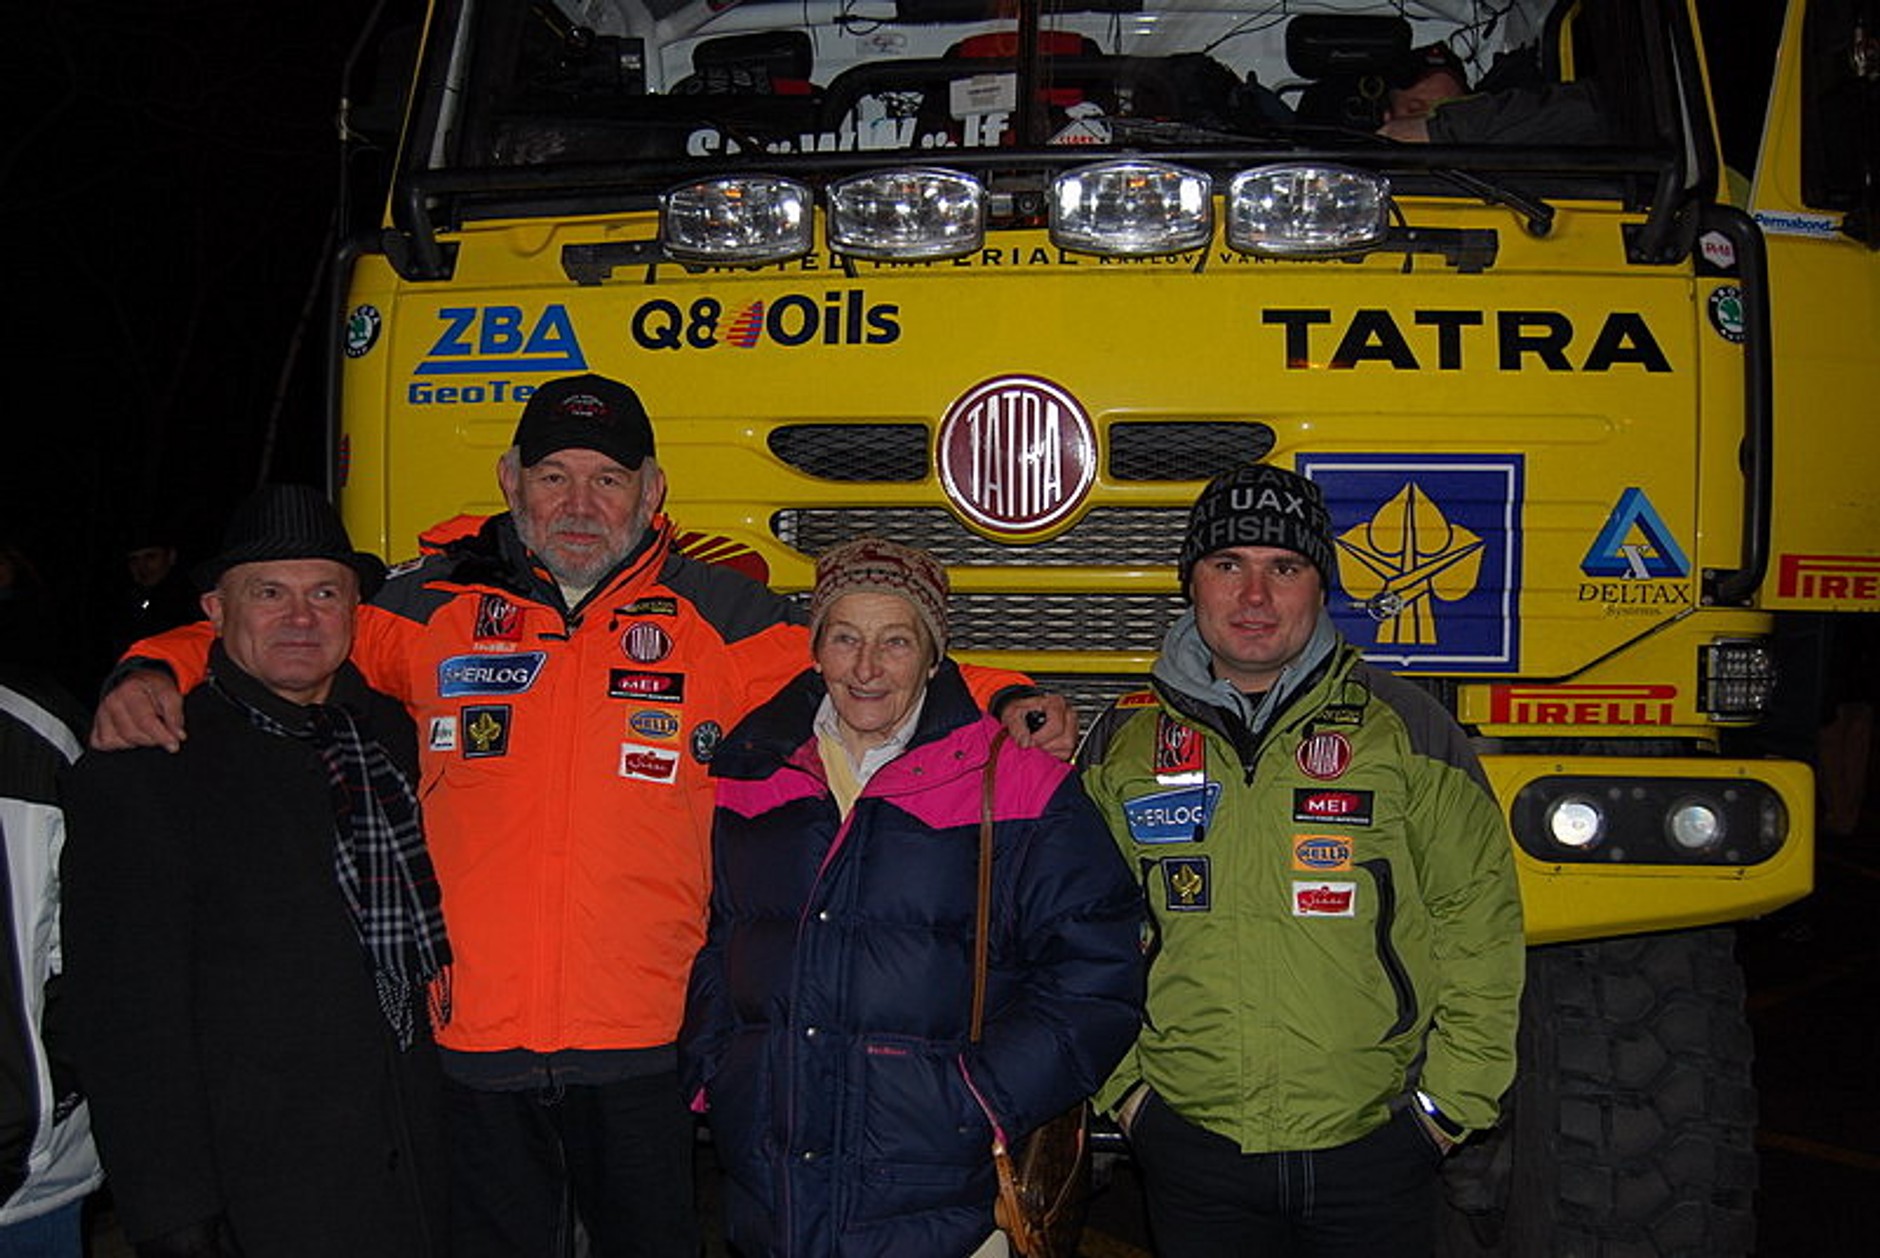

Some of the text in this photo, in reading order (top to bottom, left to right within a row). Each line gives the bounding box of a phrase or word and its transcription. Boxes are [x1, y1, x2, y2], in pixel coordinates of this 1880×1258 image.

[427, 304, 587, 358] ZBA
[632, 289, 901, 350] Q8 Oils
[1262, 308, 1673, 373] TATRA
[407, 380, 537, 404] GeoTe
[967, 391, 1062, 518] TATRA
[1231, 488, 1305, 519] UAX
[1210, 515, 1285, 546] FISH
[1579, 583, 1691, 604] DELTAX
[1777, 553, 1880, 599] PIRE
[1490, 685, 1678, 726] PIRELLI
[1308, 800, 1346, 813] MEI
